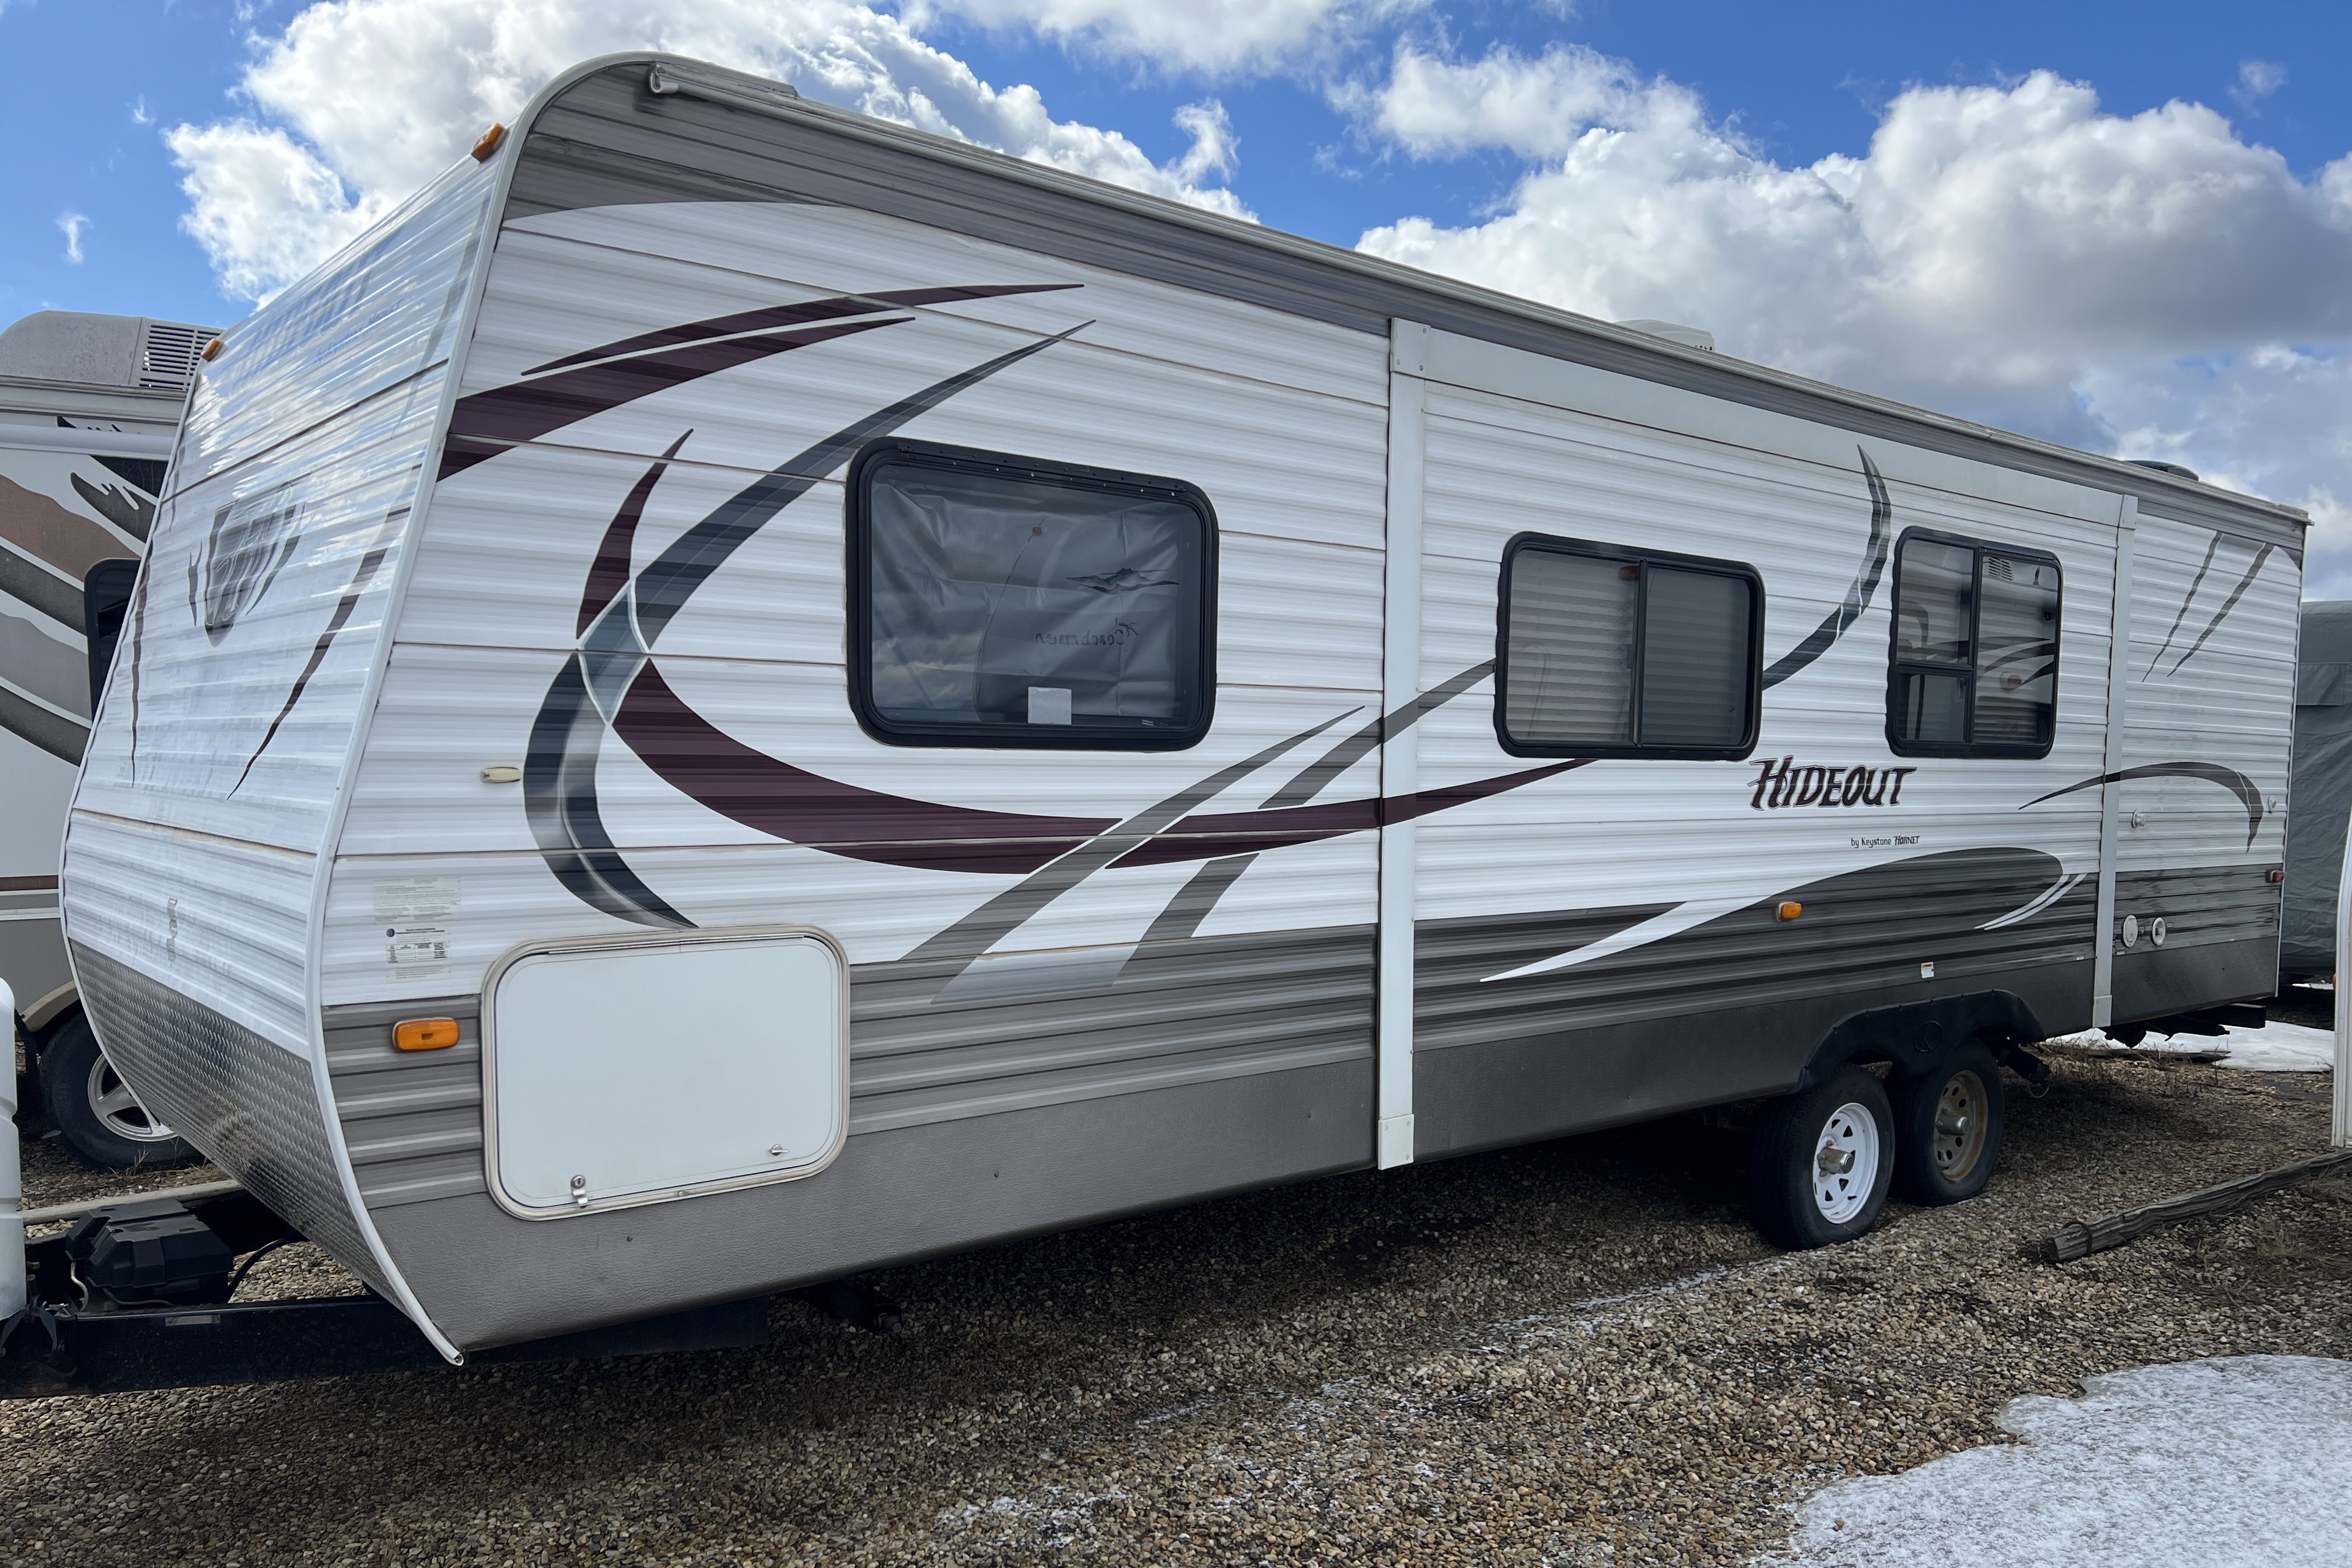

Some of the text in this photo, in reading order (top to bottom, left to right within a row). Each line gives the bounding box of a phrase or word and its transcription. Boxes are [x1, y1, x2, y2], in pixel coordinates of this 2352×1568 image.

[1747, 755, 1917, 811] HIDEOUT
[1851, 835, 1920, 849] by Keystone HORNET
